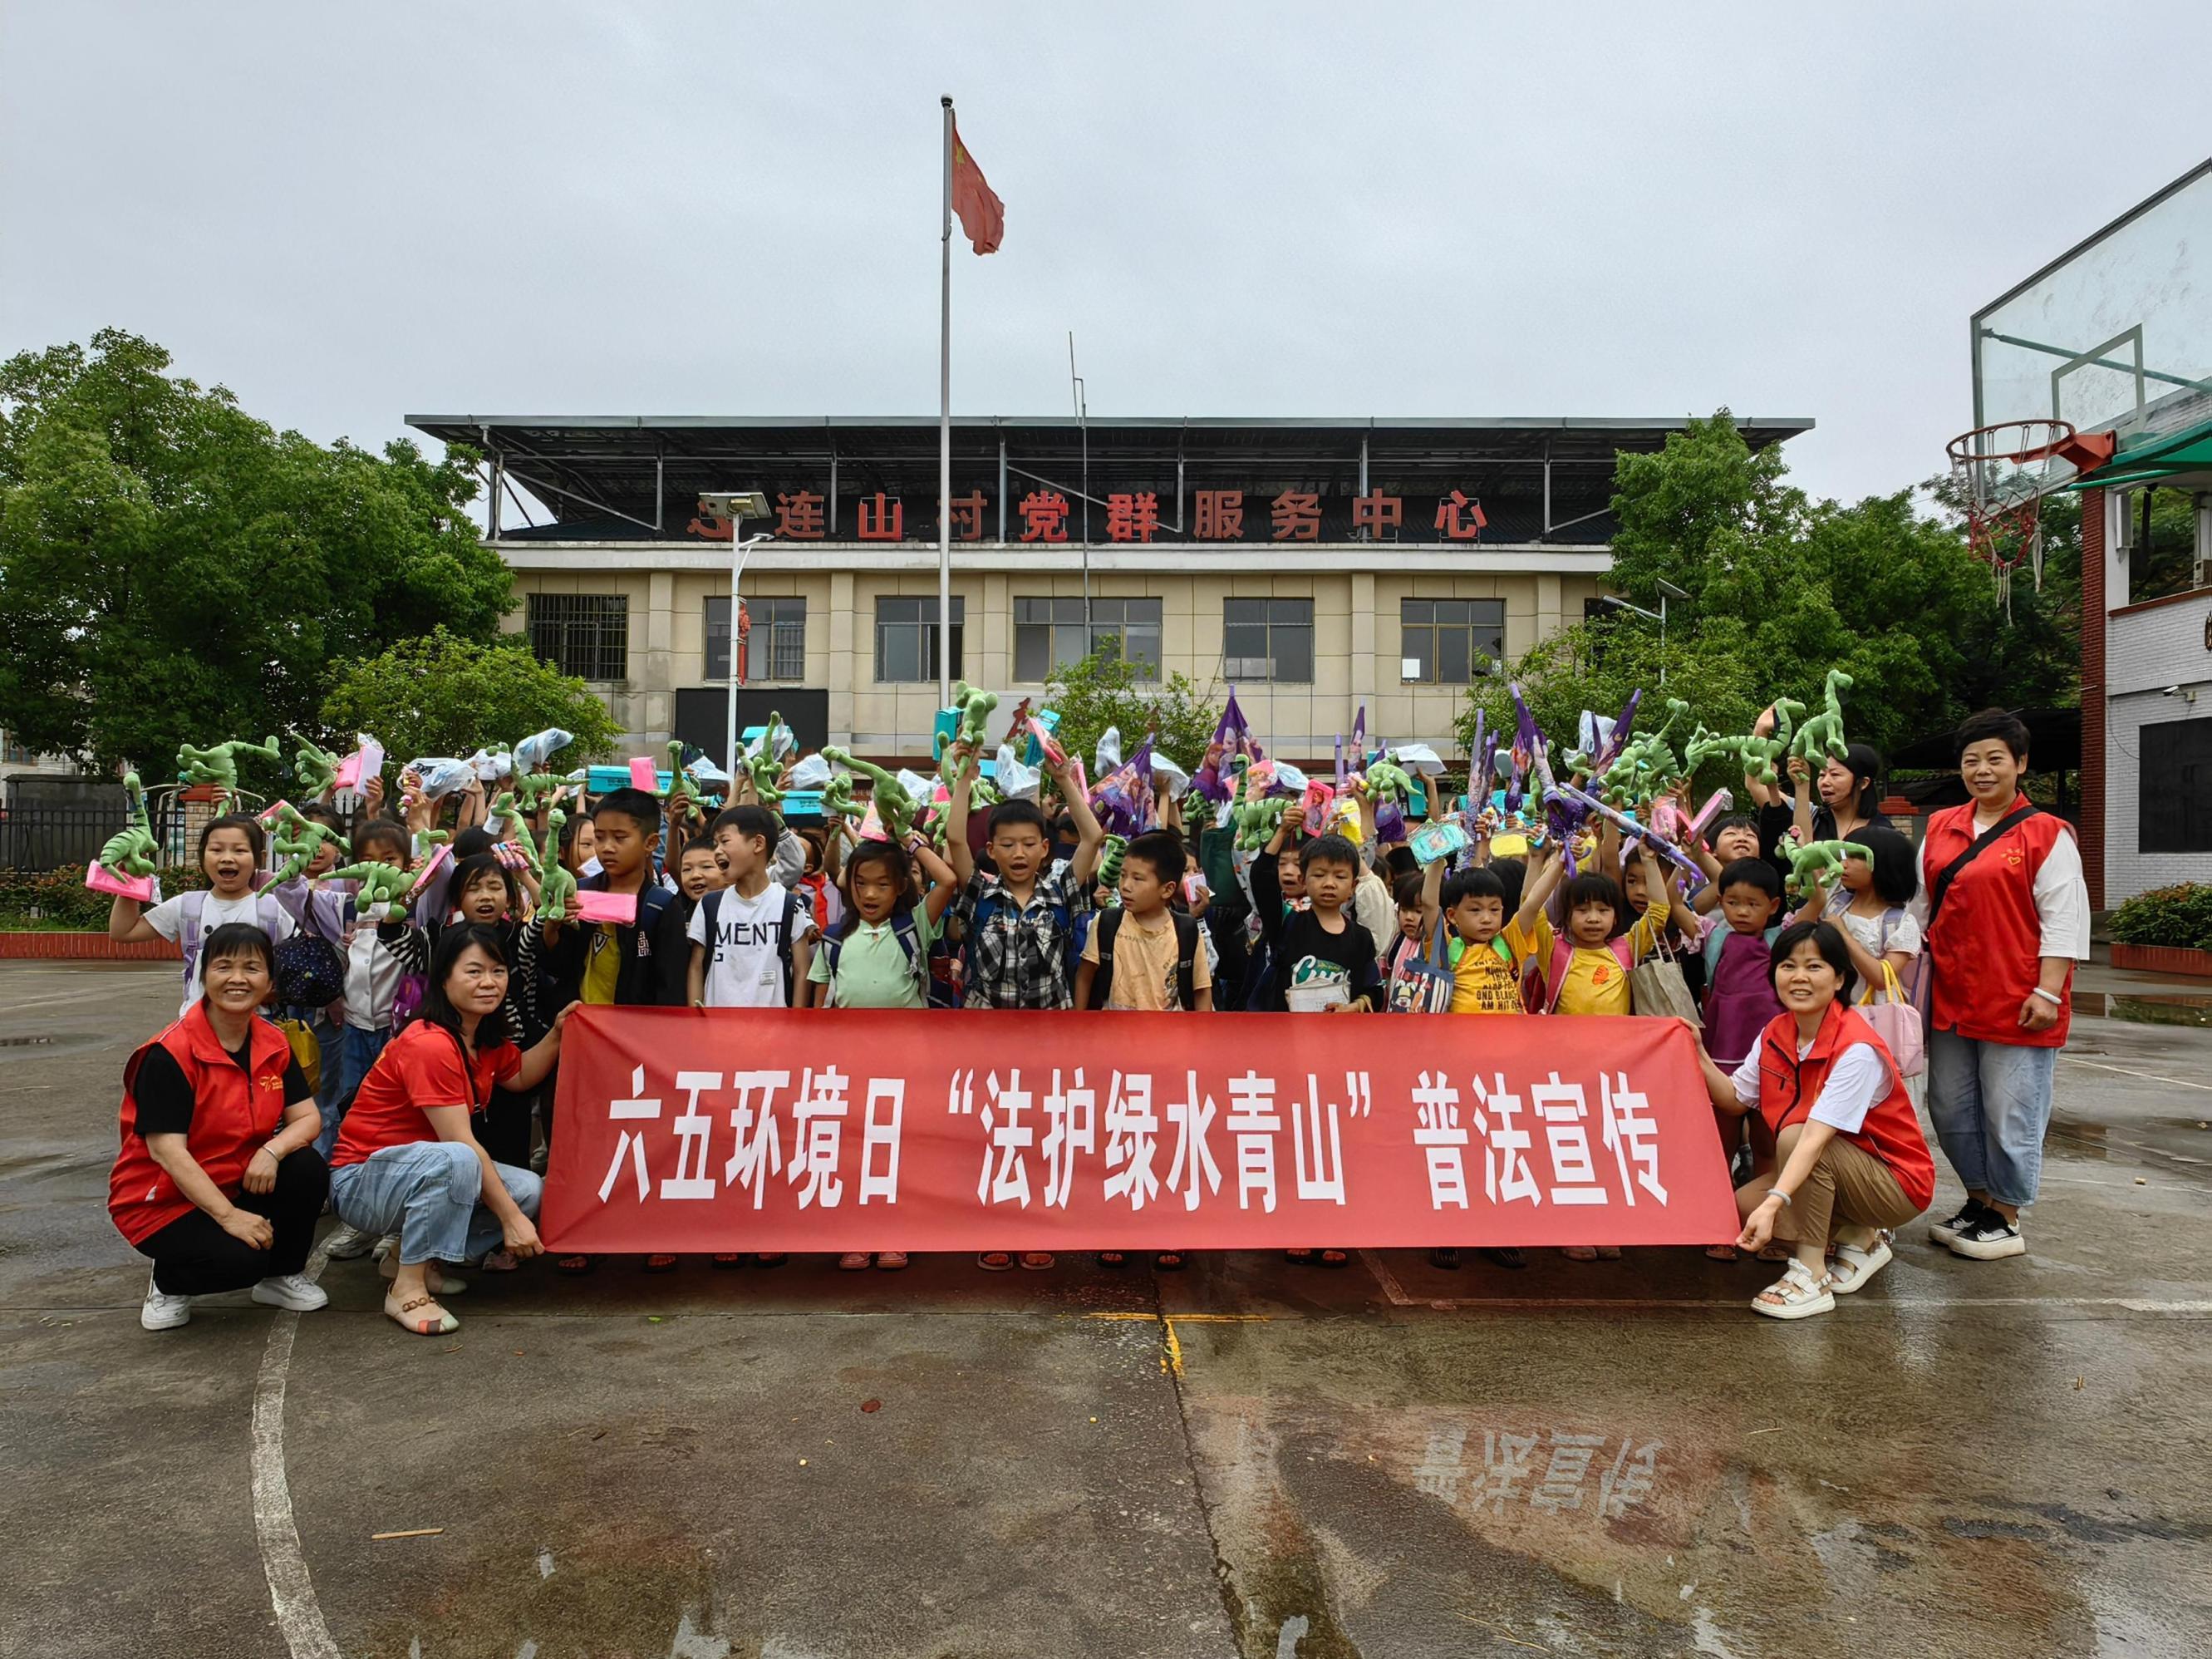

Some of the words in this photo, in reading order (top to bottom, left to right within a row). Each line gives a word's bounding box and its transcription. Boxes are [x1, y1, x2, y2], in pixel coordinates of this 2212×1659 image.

[686, 488, 1487, 543] 连山村党群服务中心
